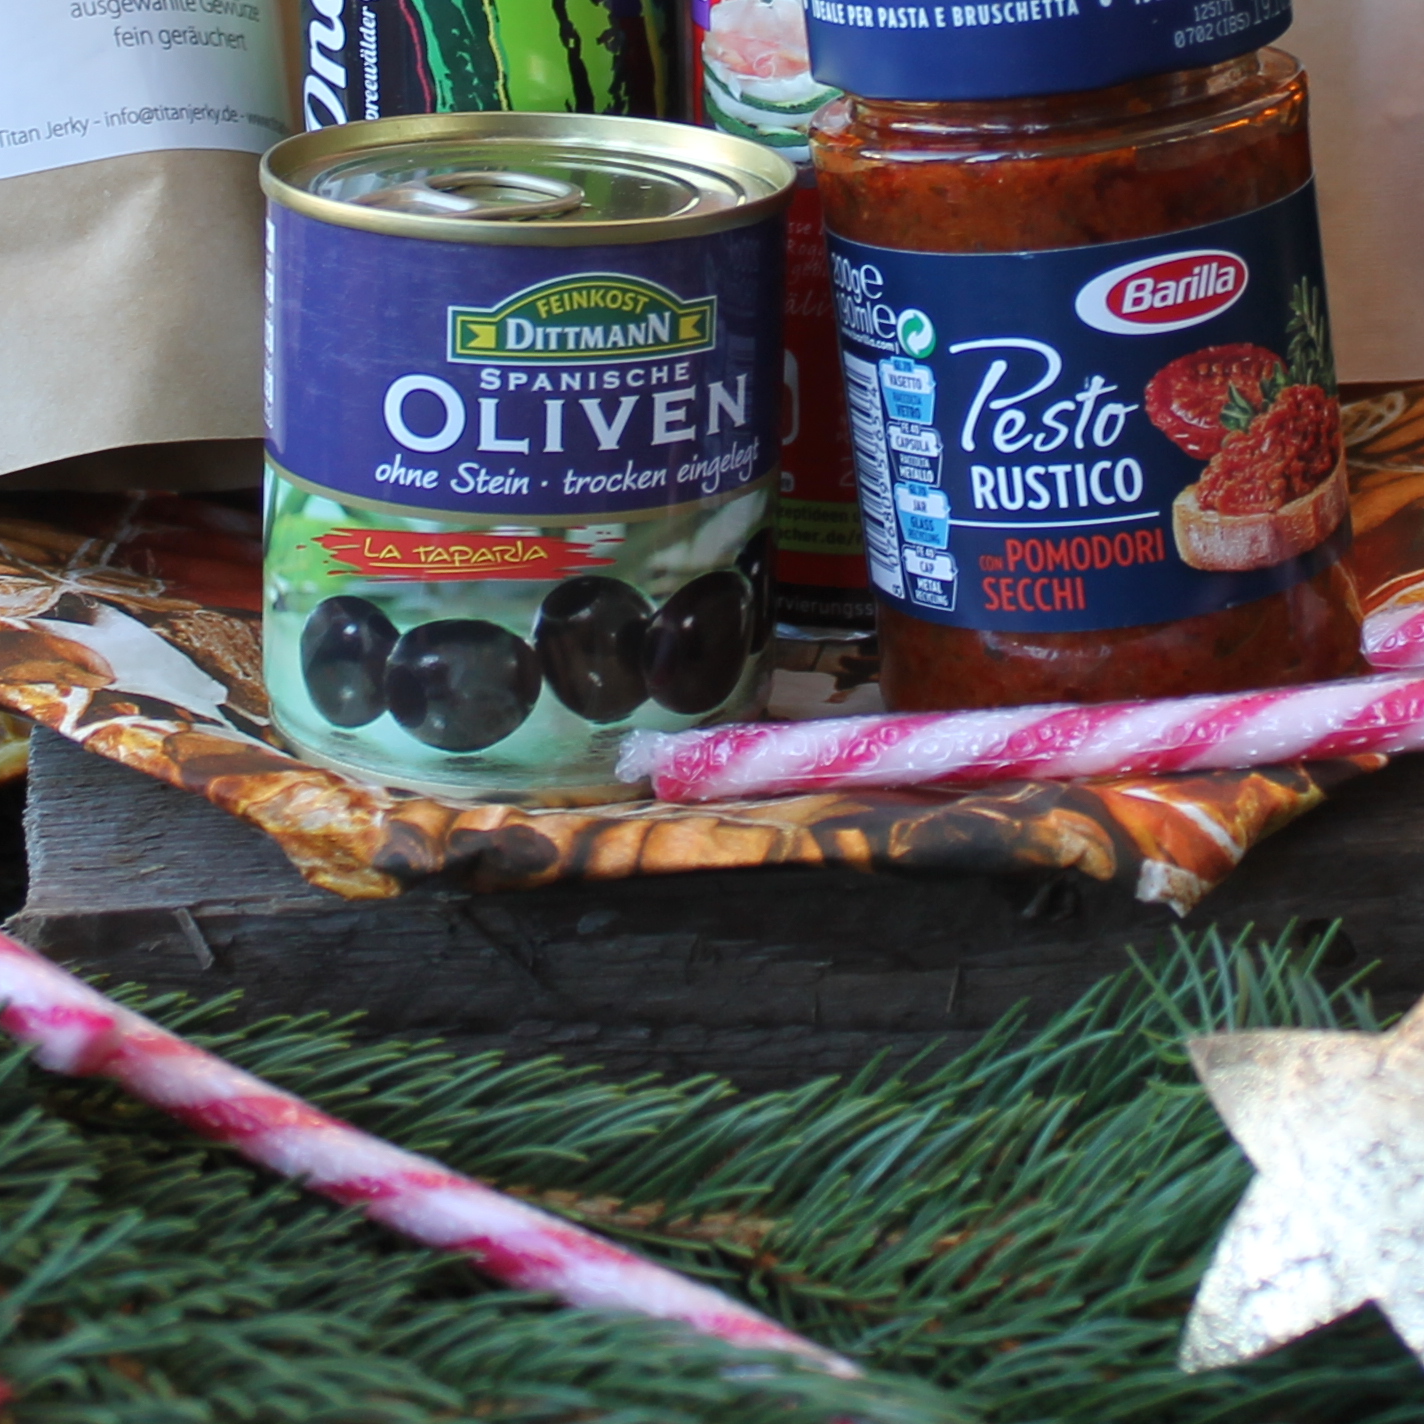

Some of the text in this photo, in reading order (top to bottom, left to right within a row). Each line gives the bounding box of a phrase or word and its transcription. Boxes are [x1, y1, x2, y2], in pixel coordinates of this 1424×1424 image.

[847, 4, 874, 27] PER
[877, 7, 929, 28] PASTA
[934, 7, 947, 27] E
[113, 26, 247, 51] fein geräuchert
[45, 117, 89, 140] Jerky
[104, 105, 238, 128] info@titanjerky.de
[535, 288, 650, 320] FEINKOST
[1121, 263, 1236, 315] Barilla
[505, 310, 672, 352] DITTMANN
[479, 362, 690, 393] SPANISCHE
[949, 337, 1139, 453] Pesto
[383, 373, 748, 455] OLIVEN
[375, 453, 439, 490] ohne
[450, 463, 530, 496] Stein
[562, 462, 668, 495] trocken
[676, 440, 760, 493] eingelegt
[971, 458, 1143, 511] RUSTICO
[980, 529, 1165, 572] CON POMODORI
[983, 576, 1086, 611] SECCHI
